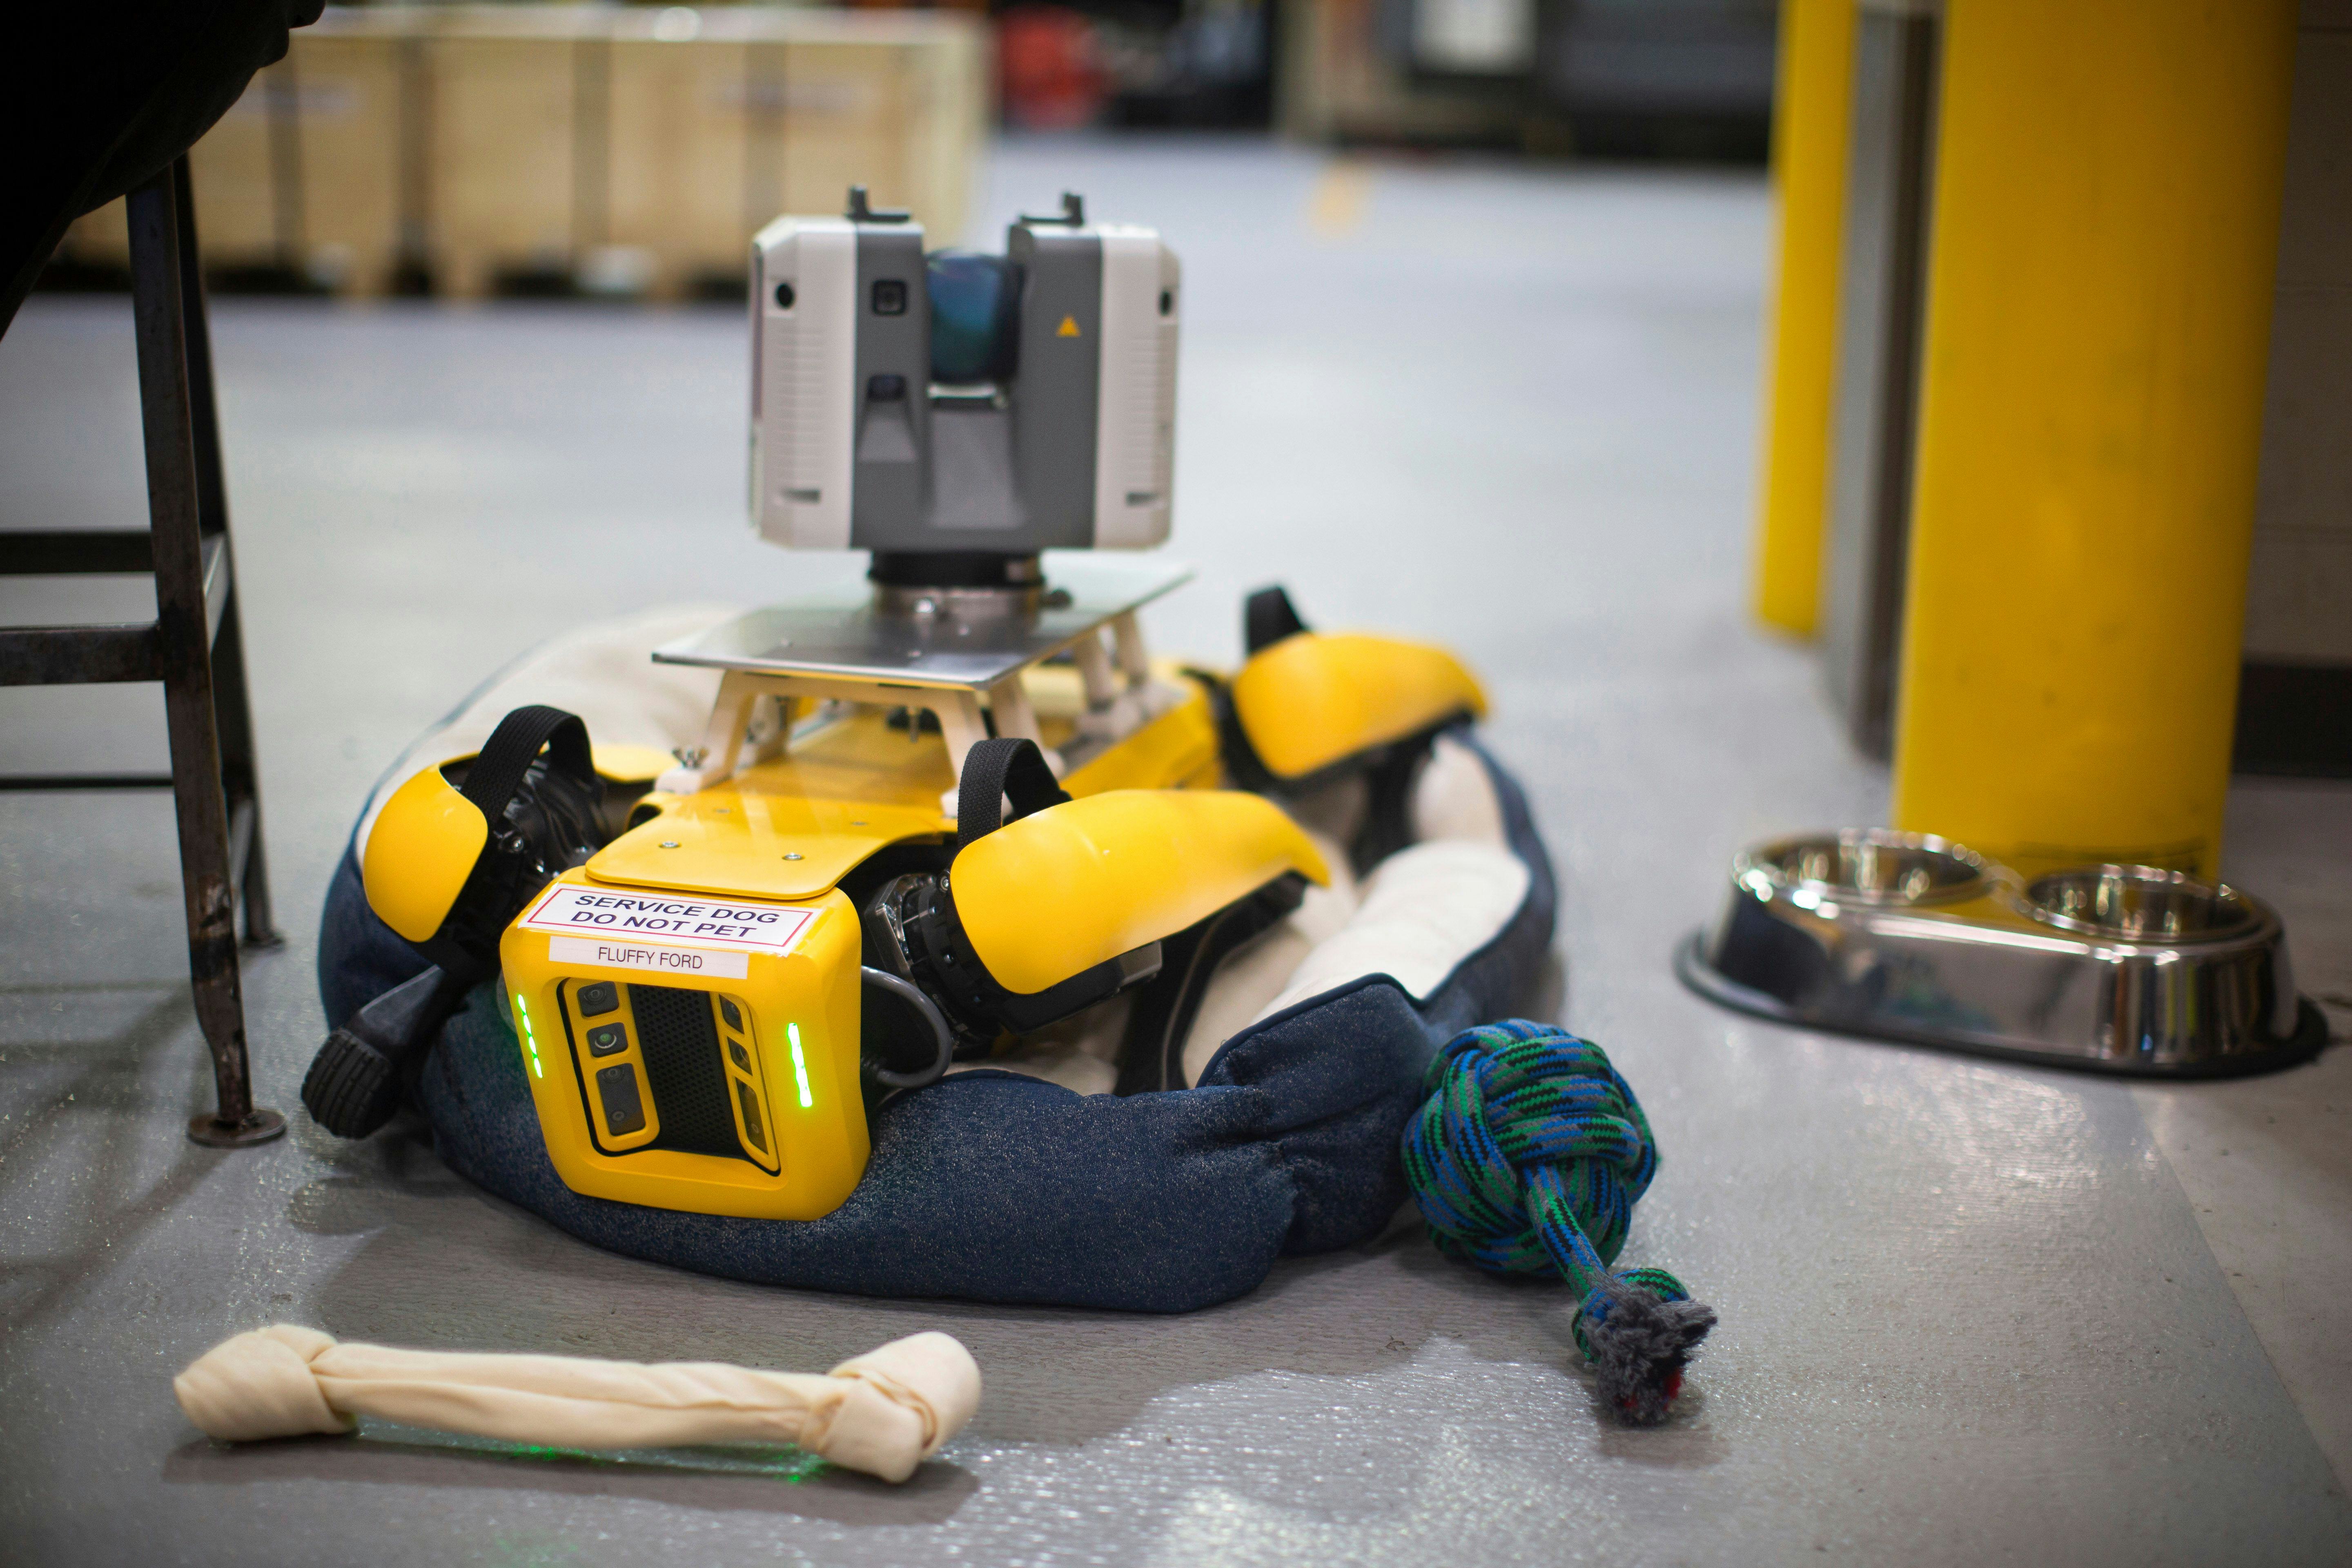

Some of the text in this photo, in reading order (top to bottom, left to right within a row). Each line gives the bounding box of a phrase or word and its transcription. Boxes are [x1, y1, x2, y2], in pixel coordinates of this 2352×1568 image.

[575, 895, 780, 923] SERVICE DOG
[570, 911, 757, 937] DO NOT PET
[599, 947, 702, 969] FLUFFY FORD
